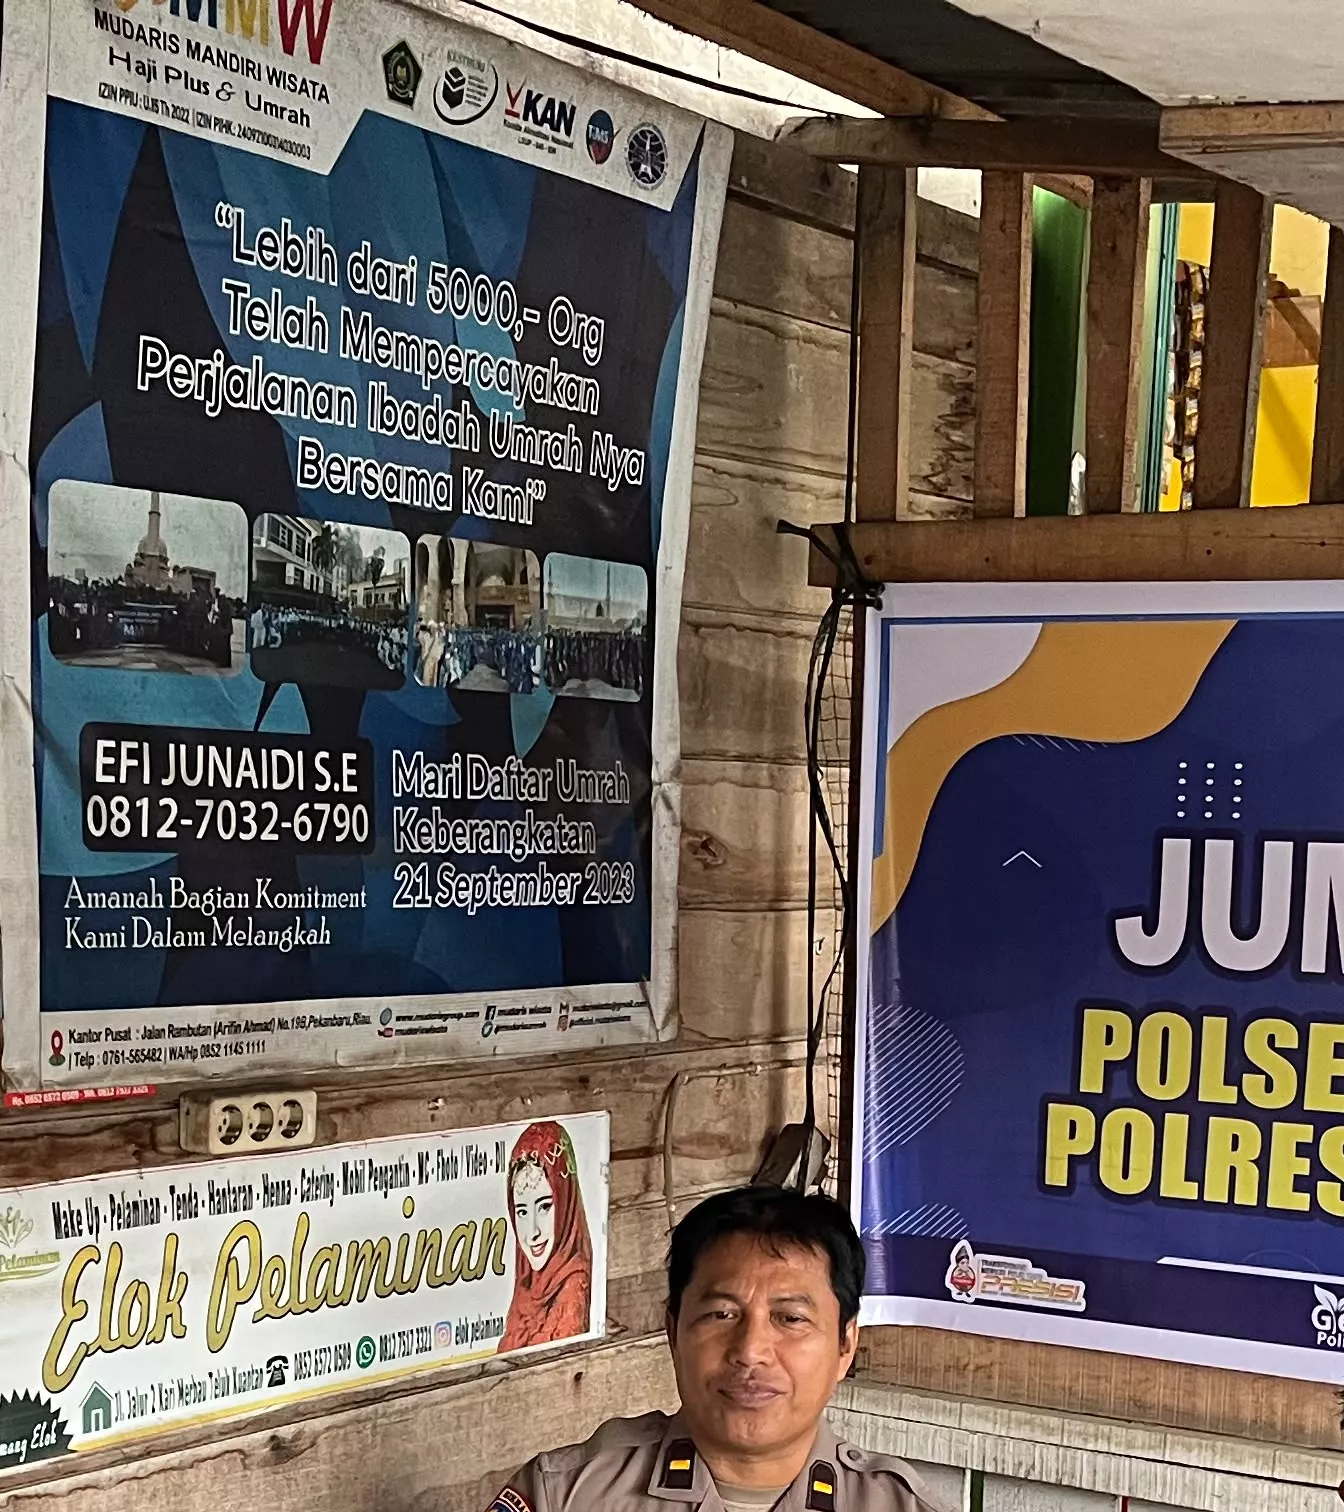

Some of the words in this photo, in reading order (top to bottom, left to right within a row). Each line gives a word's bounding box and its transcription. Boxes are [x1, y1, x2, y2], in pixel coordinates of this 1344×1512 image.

[94, 7, 180, 54] MUDARIS
[185, 39, 262, 82] MANDIRI
[266, 64, 330, 104] WISATA
[109, 46, 158, 84] Haji
[165, 65, 210, 96] Plus
[215, 81, 236, 102] &
[244, 90, 311, 128] Umrah
[522, 89, 577, 138] KAN
[346, 241, 418, 306] dari
[548, 296, 605, 366] Org
[222, 279, 329, 353] Telah
[340, 308, 601, 415] Mempercayakan
[136, 334, 357, 428] Perjalanan
[368, 381, 480, 452] Ibadah
[488, 408, 582, 474] Umrah
[590, 430, 646, 492] Nya
[297, 437, 453, 511] Bersama
[95, 740, 151, 786] EFI
[162, 744, 305, 791] JUNAIDI
[314, 753, 358, 793] S.E
[393, 750, 462, 799] Mari
[467, 754, 553, 801] Daftar
[556, 759, 630, 804] Umrah
[86, 795, 369, 843] 0812-7032-6790
[393, 806, 596, 862] Keberangkatan
[64, 876, 164, 909] Amanah
[169, 876, 249, 916] Bagian
[255, 878, 367, 909] Komitment
[393, 862, 432, 908] 21
[435, 861, 582, 916] September
[583, 862, 635, 904] 2023
[65, 917, 126, 949] Kami
[132, 916, 206, 948] Dalam
[210, 915, 331, 952] Melangkah
[68, 1028, 103, 1044] Kantor
[105, 1027, 131, 1042] Pusat
[141, 1025, 166, 1040] Jalan
[167, 1021, 211, 1038] Rambutan
[74, 1051, 94, 1068] Telp
[52, 1200, 83, 1240] Make
[85, 1197, 100, 1244] Up
[109, 1190, 161, 1231] Pelaminan
[169, 1183, 199, 1221] Tenda
[207, 1178, 254, 1215] Hantaran
[262, 1173, 291, 1208] Henna
[300, 1165, 335, 1207] Catering
[342, 1158, 365, 1196] Mobil
[367, 1154, 410, 1199] Pengantin
[417, 1151, 430, 1185] MC
[465, 1144, 488, 1178] Video
[41, 1233, 188, 1393] Elok
[206, 1196, 507, 1353] Pelaminan
[30, 1418, 57, 1449] Elok
